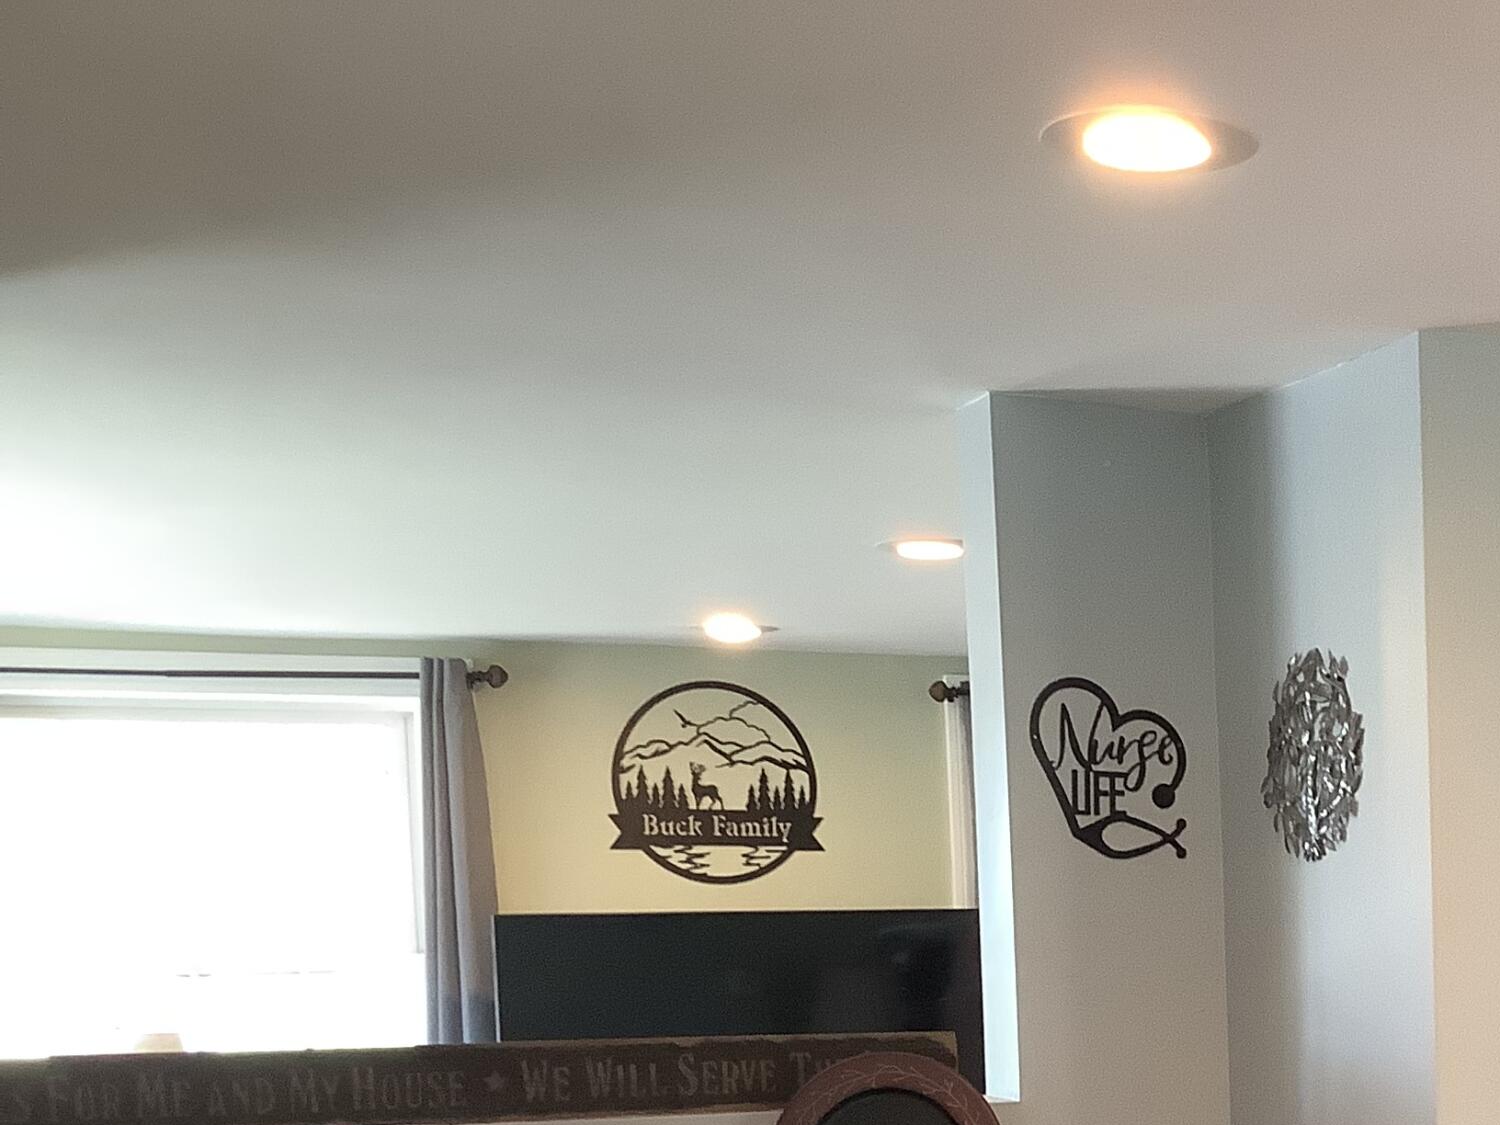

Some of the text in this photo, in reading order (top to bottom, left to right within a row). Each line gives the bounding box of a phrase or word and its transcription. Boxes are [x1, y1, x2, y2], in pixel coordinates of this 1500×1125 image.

[1051, 702, 1174, 792] Nurse
[1072, 769, 1127, 817] LIFE
[642, 814, 792, 842] Buck Family
